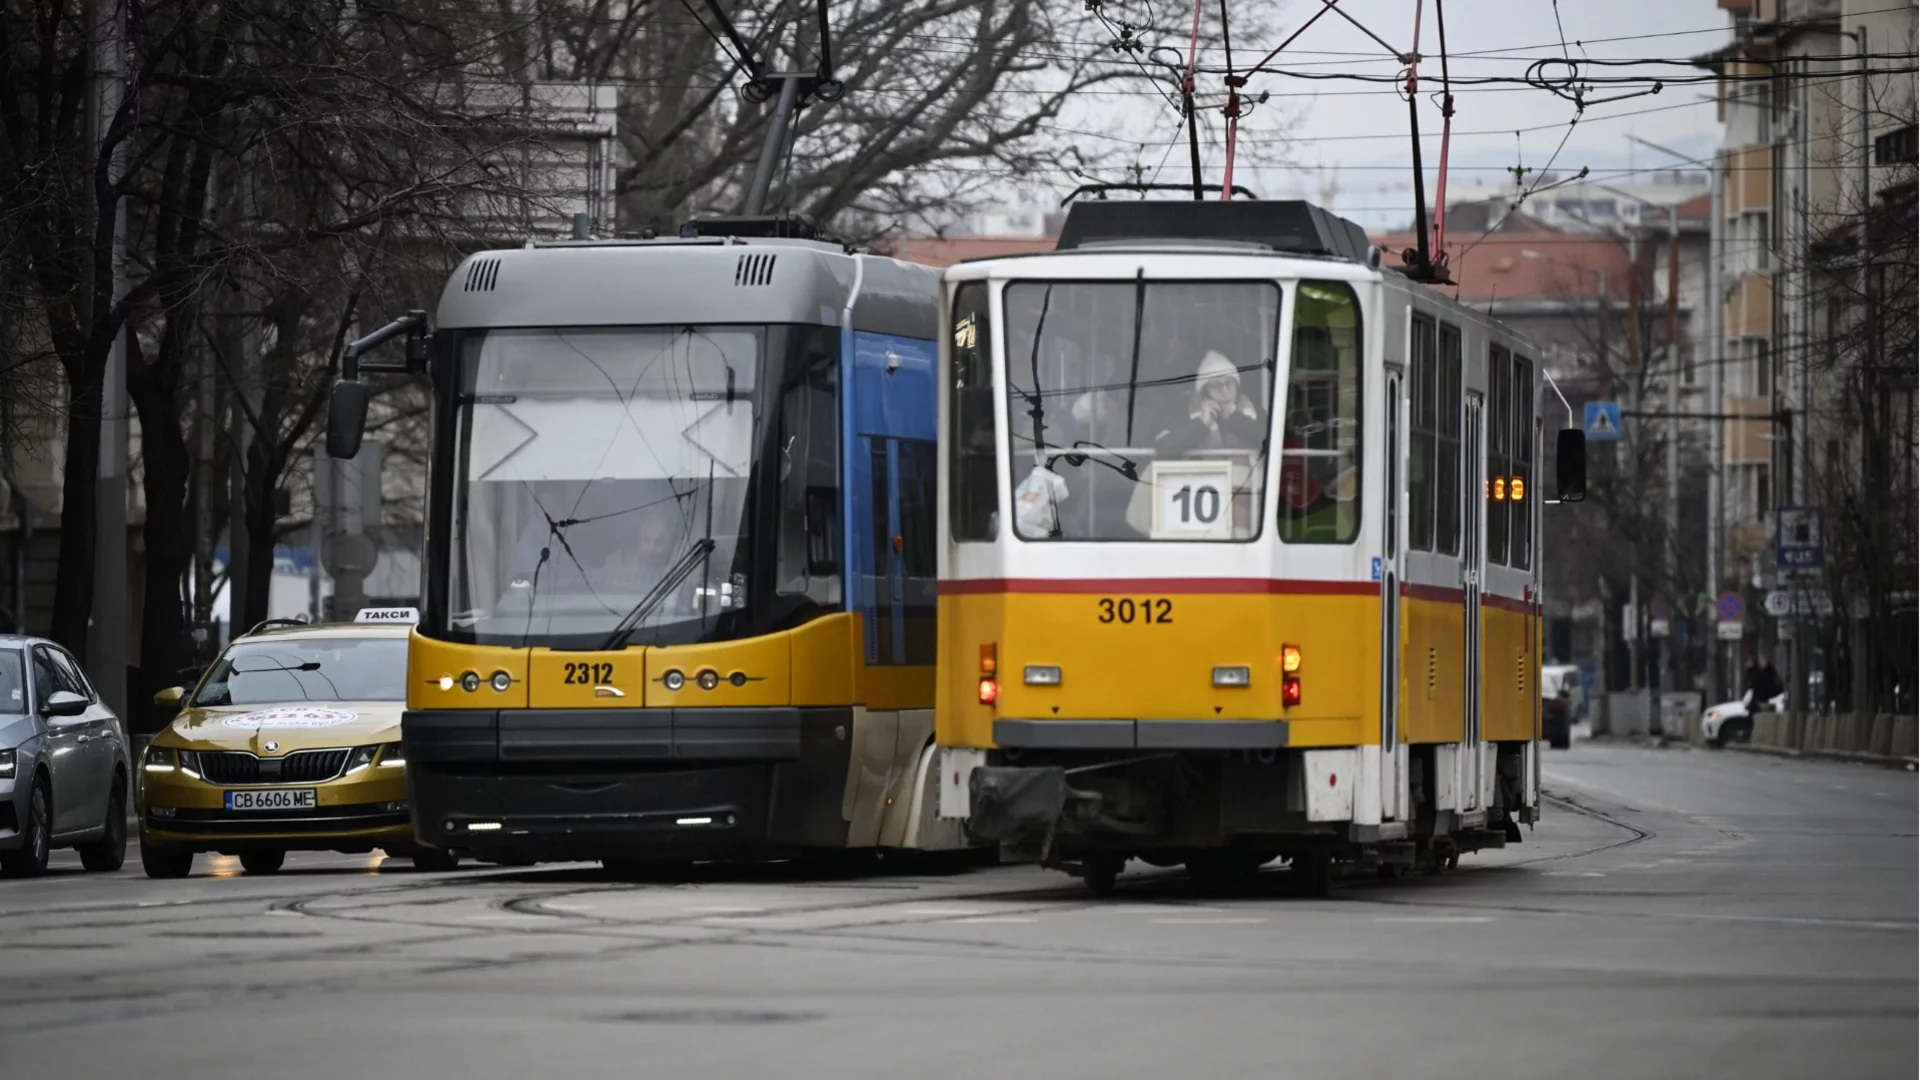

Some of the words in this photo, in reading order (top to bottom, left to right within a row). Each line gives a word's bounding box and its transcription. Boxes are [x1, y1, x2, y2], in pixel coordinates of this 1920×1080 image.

[1172, 485, 1220, 524] 10
[364, 610, 410, 619] ТАКСИ
[1098, 598, 1173, 624] 3012
[564, 662, 613, 684] 2312
[234, 793, 253, 808] CB
[255, 792, 291, 807] 6606
[293, 791, 313, 806] ME
